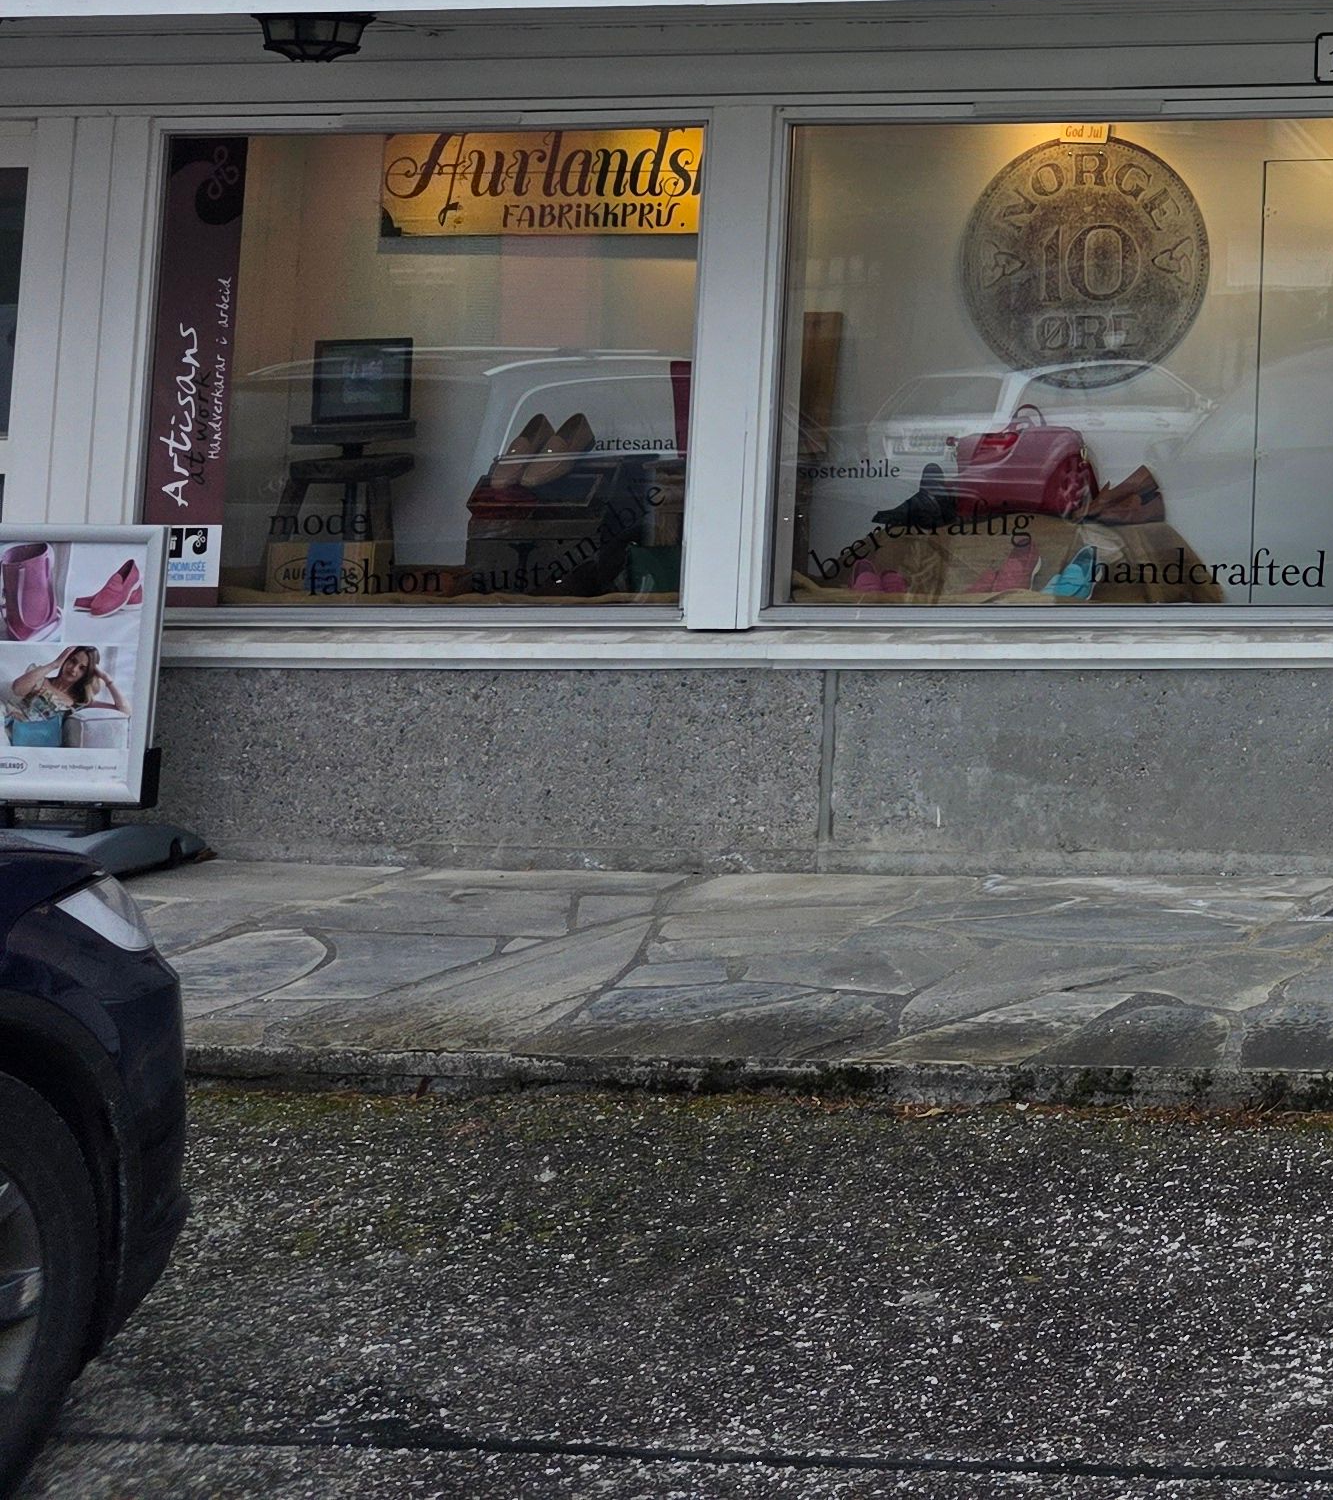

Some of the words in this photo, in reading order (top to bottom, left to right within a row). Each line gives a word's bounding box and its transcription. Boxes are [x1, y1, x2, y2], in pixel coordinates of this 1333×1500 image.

[1065, 127, 1084, 138] God
[1087, 125, 1103, 139] Jul
[386, 127, 704, 227] Aurlands
[1002, 152, 1181, 233] NORGE
[1041, 224, 1142, 302] 10
[217, 276, 232, 328] arbeid
[1034, 311, 1142, 351] ØRE
[159, 322, 201, 508] Artisans
[184, 449, 206, 486] at
[195, 369, 212, 442] work
[798, 459, 901, 480] sostenibile
[269, 512, 370, 536] mode
[471, 484, 666, 594] sustainable
[309, 559, 445, 596] fashion
[1089, 547, 1327, 589] handcrafted
